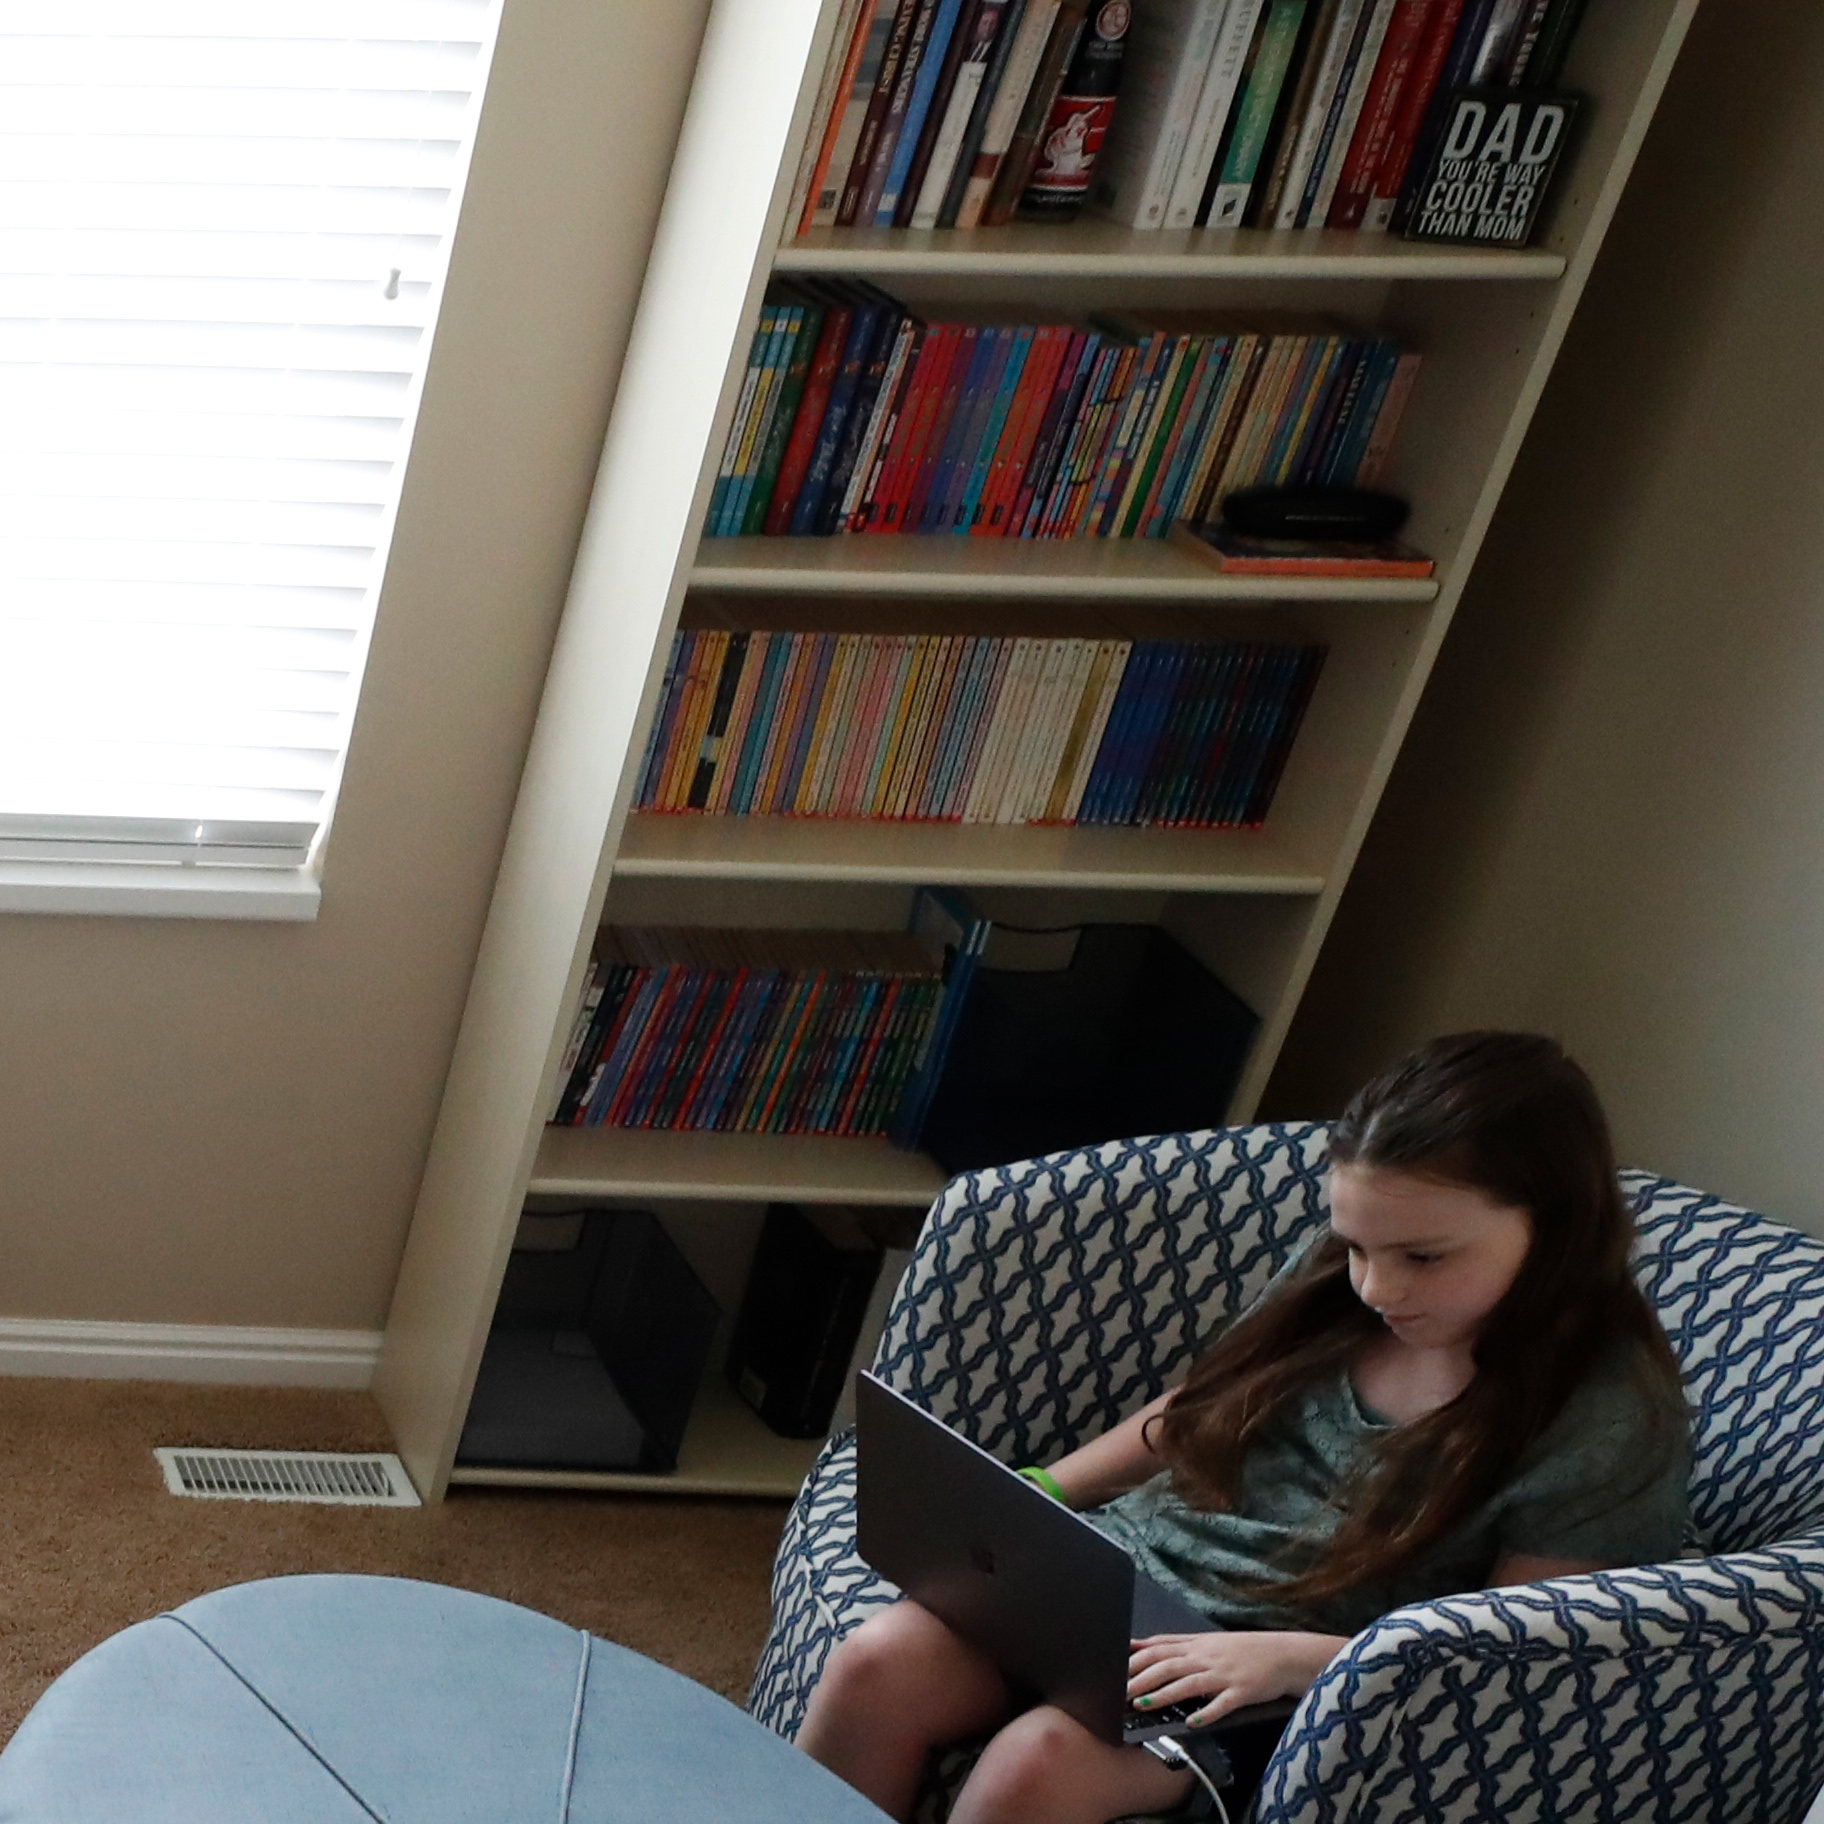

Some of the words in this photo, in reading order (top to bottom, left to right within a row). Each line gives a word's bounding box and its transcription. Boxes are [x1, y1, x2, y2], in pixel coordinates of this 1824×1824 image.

[1441, 101, 1565, 164] DAD
[1437, 159, 1500, 182] YOU'RE
[1503, 163, 1546, 186] WAY
[1425, 180, 1535, 217] COOLER
[1417, 210, 1473, 238] THAN
[1473, 215, 1527, 241] MOM
